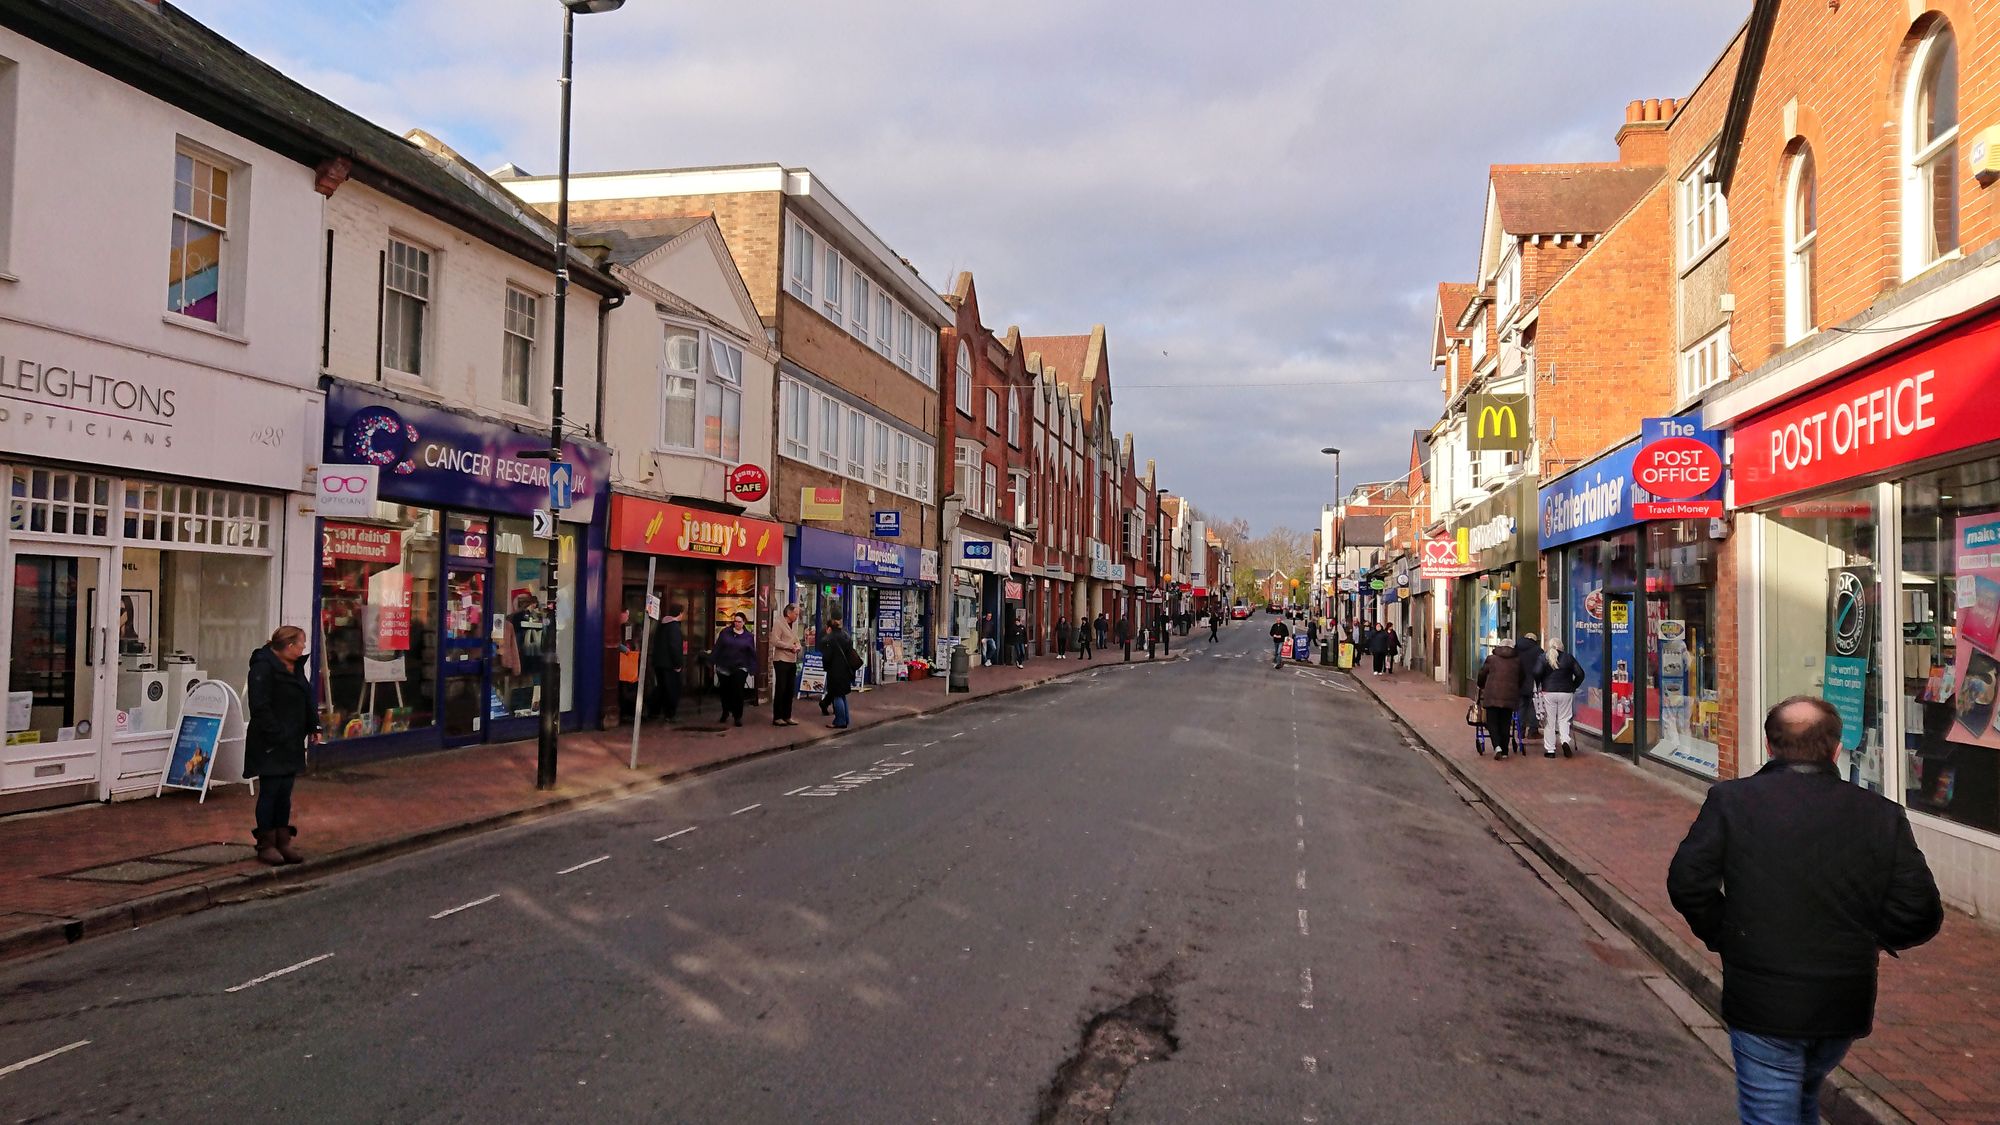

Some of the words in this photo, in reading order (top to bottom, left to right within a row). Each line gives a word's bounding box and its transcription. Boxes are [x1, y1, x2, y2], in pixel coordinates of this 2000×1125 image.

[0, 355, 176, 417] LEIGHTONS
[0, 407, 173, 448] OPTICIANS
[1659, 421, 1695, 437] The
[1771, 412, 1827, 474] POST
[1832, 369, 1935, 455] OFFICE
[424, 443, 490, 477] CANCER
[496, 458, 550, 487] RESEAR
[1654, 449, 1703, 466] POST
[734, 470, 763, 482] jenny's
[1642, 466, 1711, 483] OFFICE
[735, 483, 762, 493] CAFE
[320, 497, 366, 505] OPTICIANS
[1558, 472, 1624, 531] Entertainer
[1648, 505, 1675, 514] Travel
[1677, 505, 1710, 516] Money
[677, 512, 747, 556] jenny's
[1966, 527, 1995, 545] make
[382, 590, 410, 608] SALE
[1837, 636, 1855, 650] PRICE
